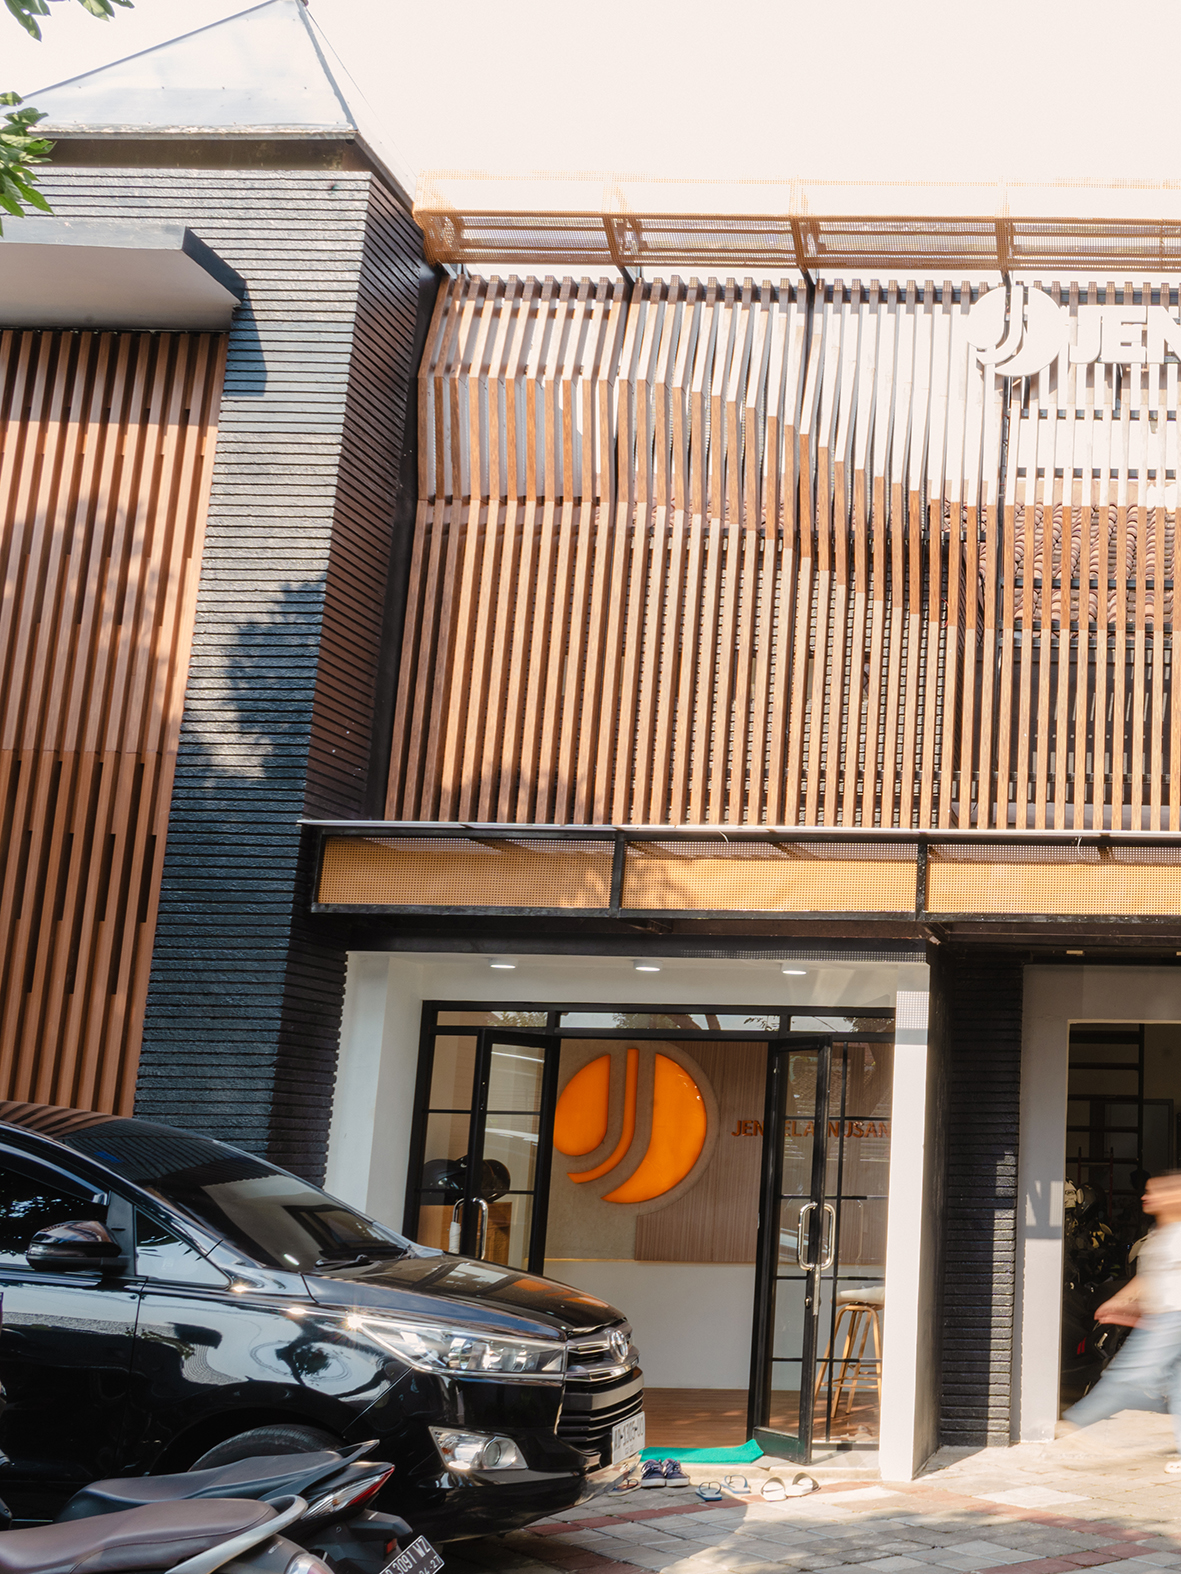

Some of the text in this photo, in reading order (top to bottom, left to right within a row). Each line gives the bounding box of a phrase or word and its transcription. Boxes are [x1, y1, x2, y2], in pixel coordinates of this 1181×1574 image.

[731, 1120, 814, 1137] JENELA
[392, 1538, 431, 1574] 3091 WZ
